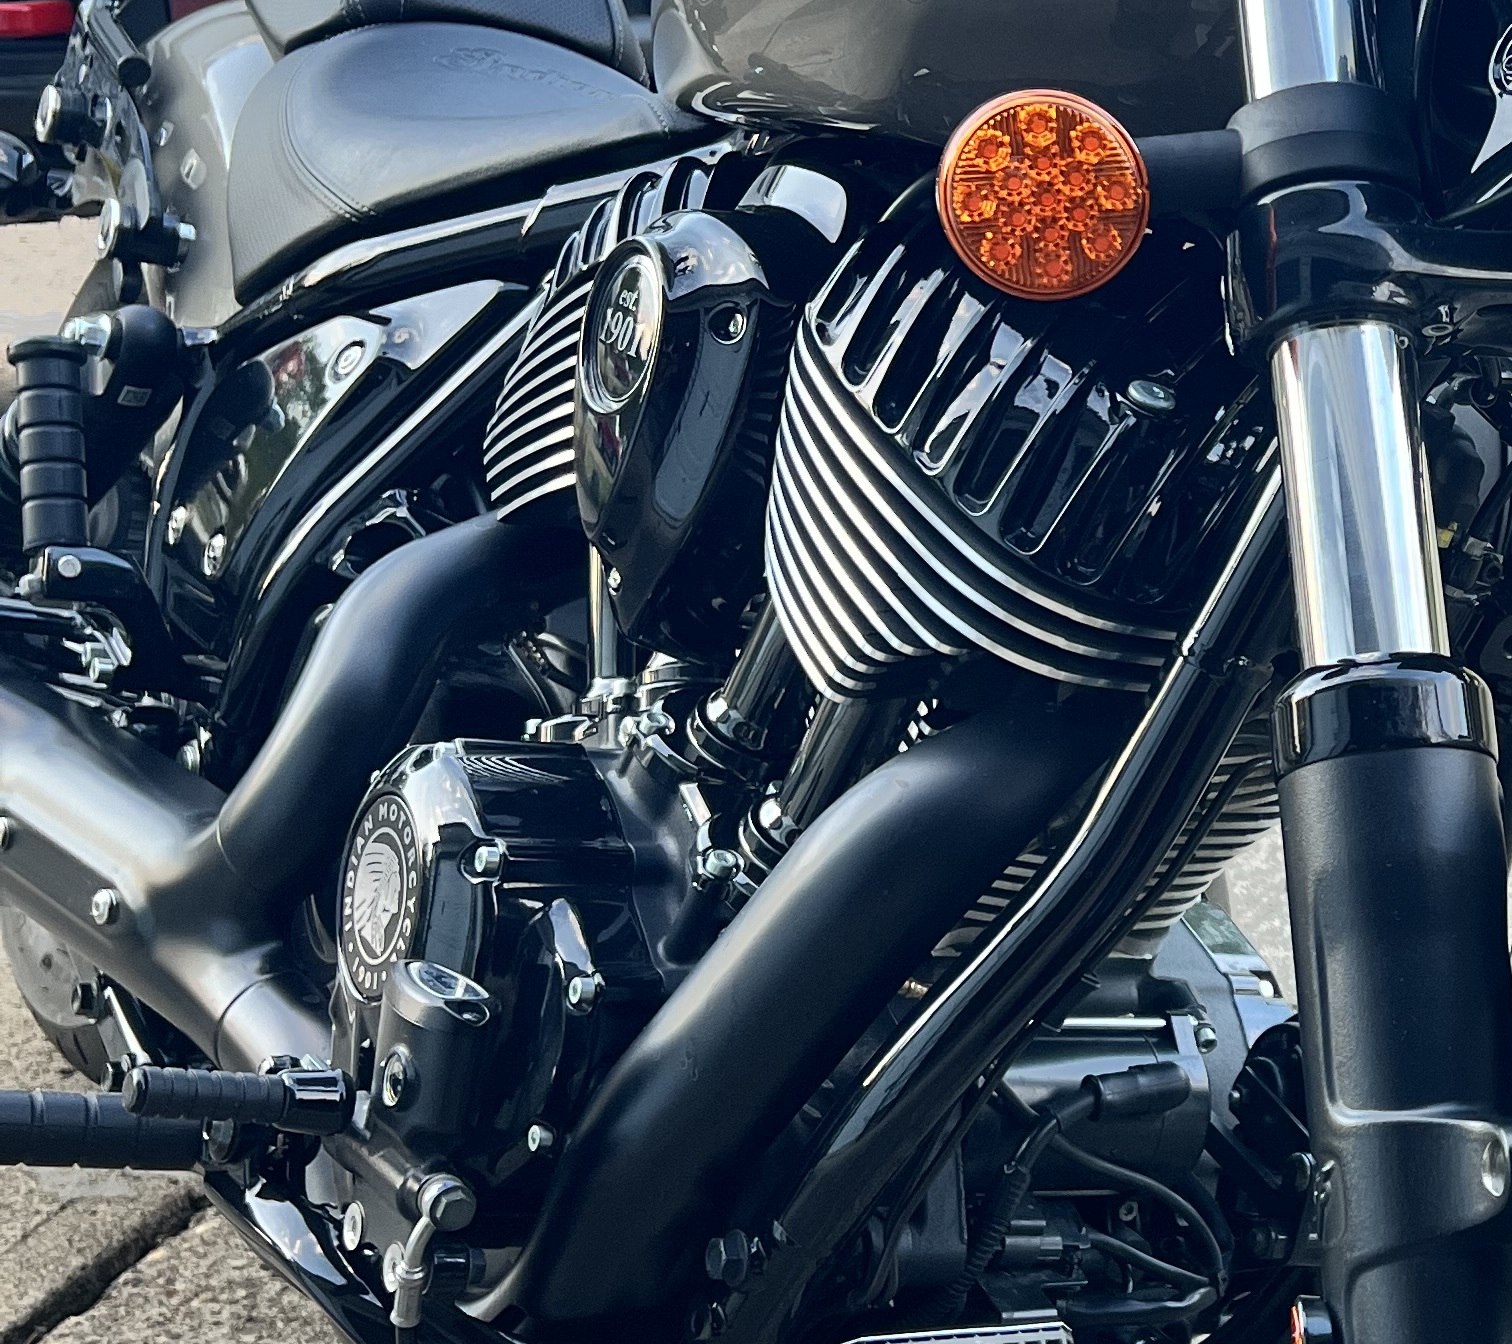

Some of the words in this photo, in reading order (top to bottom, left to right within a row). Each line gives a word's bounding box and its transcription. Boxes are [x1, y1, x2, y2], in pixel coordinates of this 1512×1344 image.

[601, 308, 645, 357] 1901
[344, 819, 375, 933] INDIAN
[378, 802, 417, 962] MOTORCYCLE
[352, 957, 378, 990] 1901
